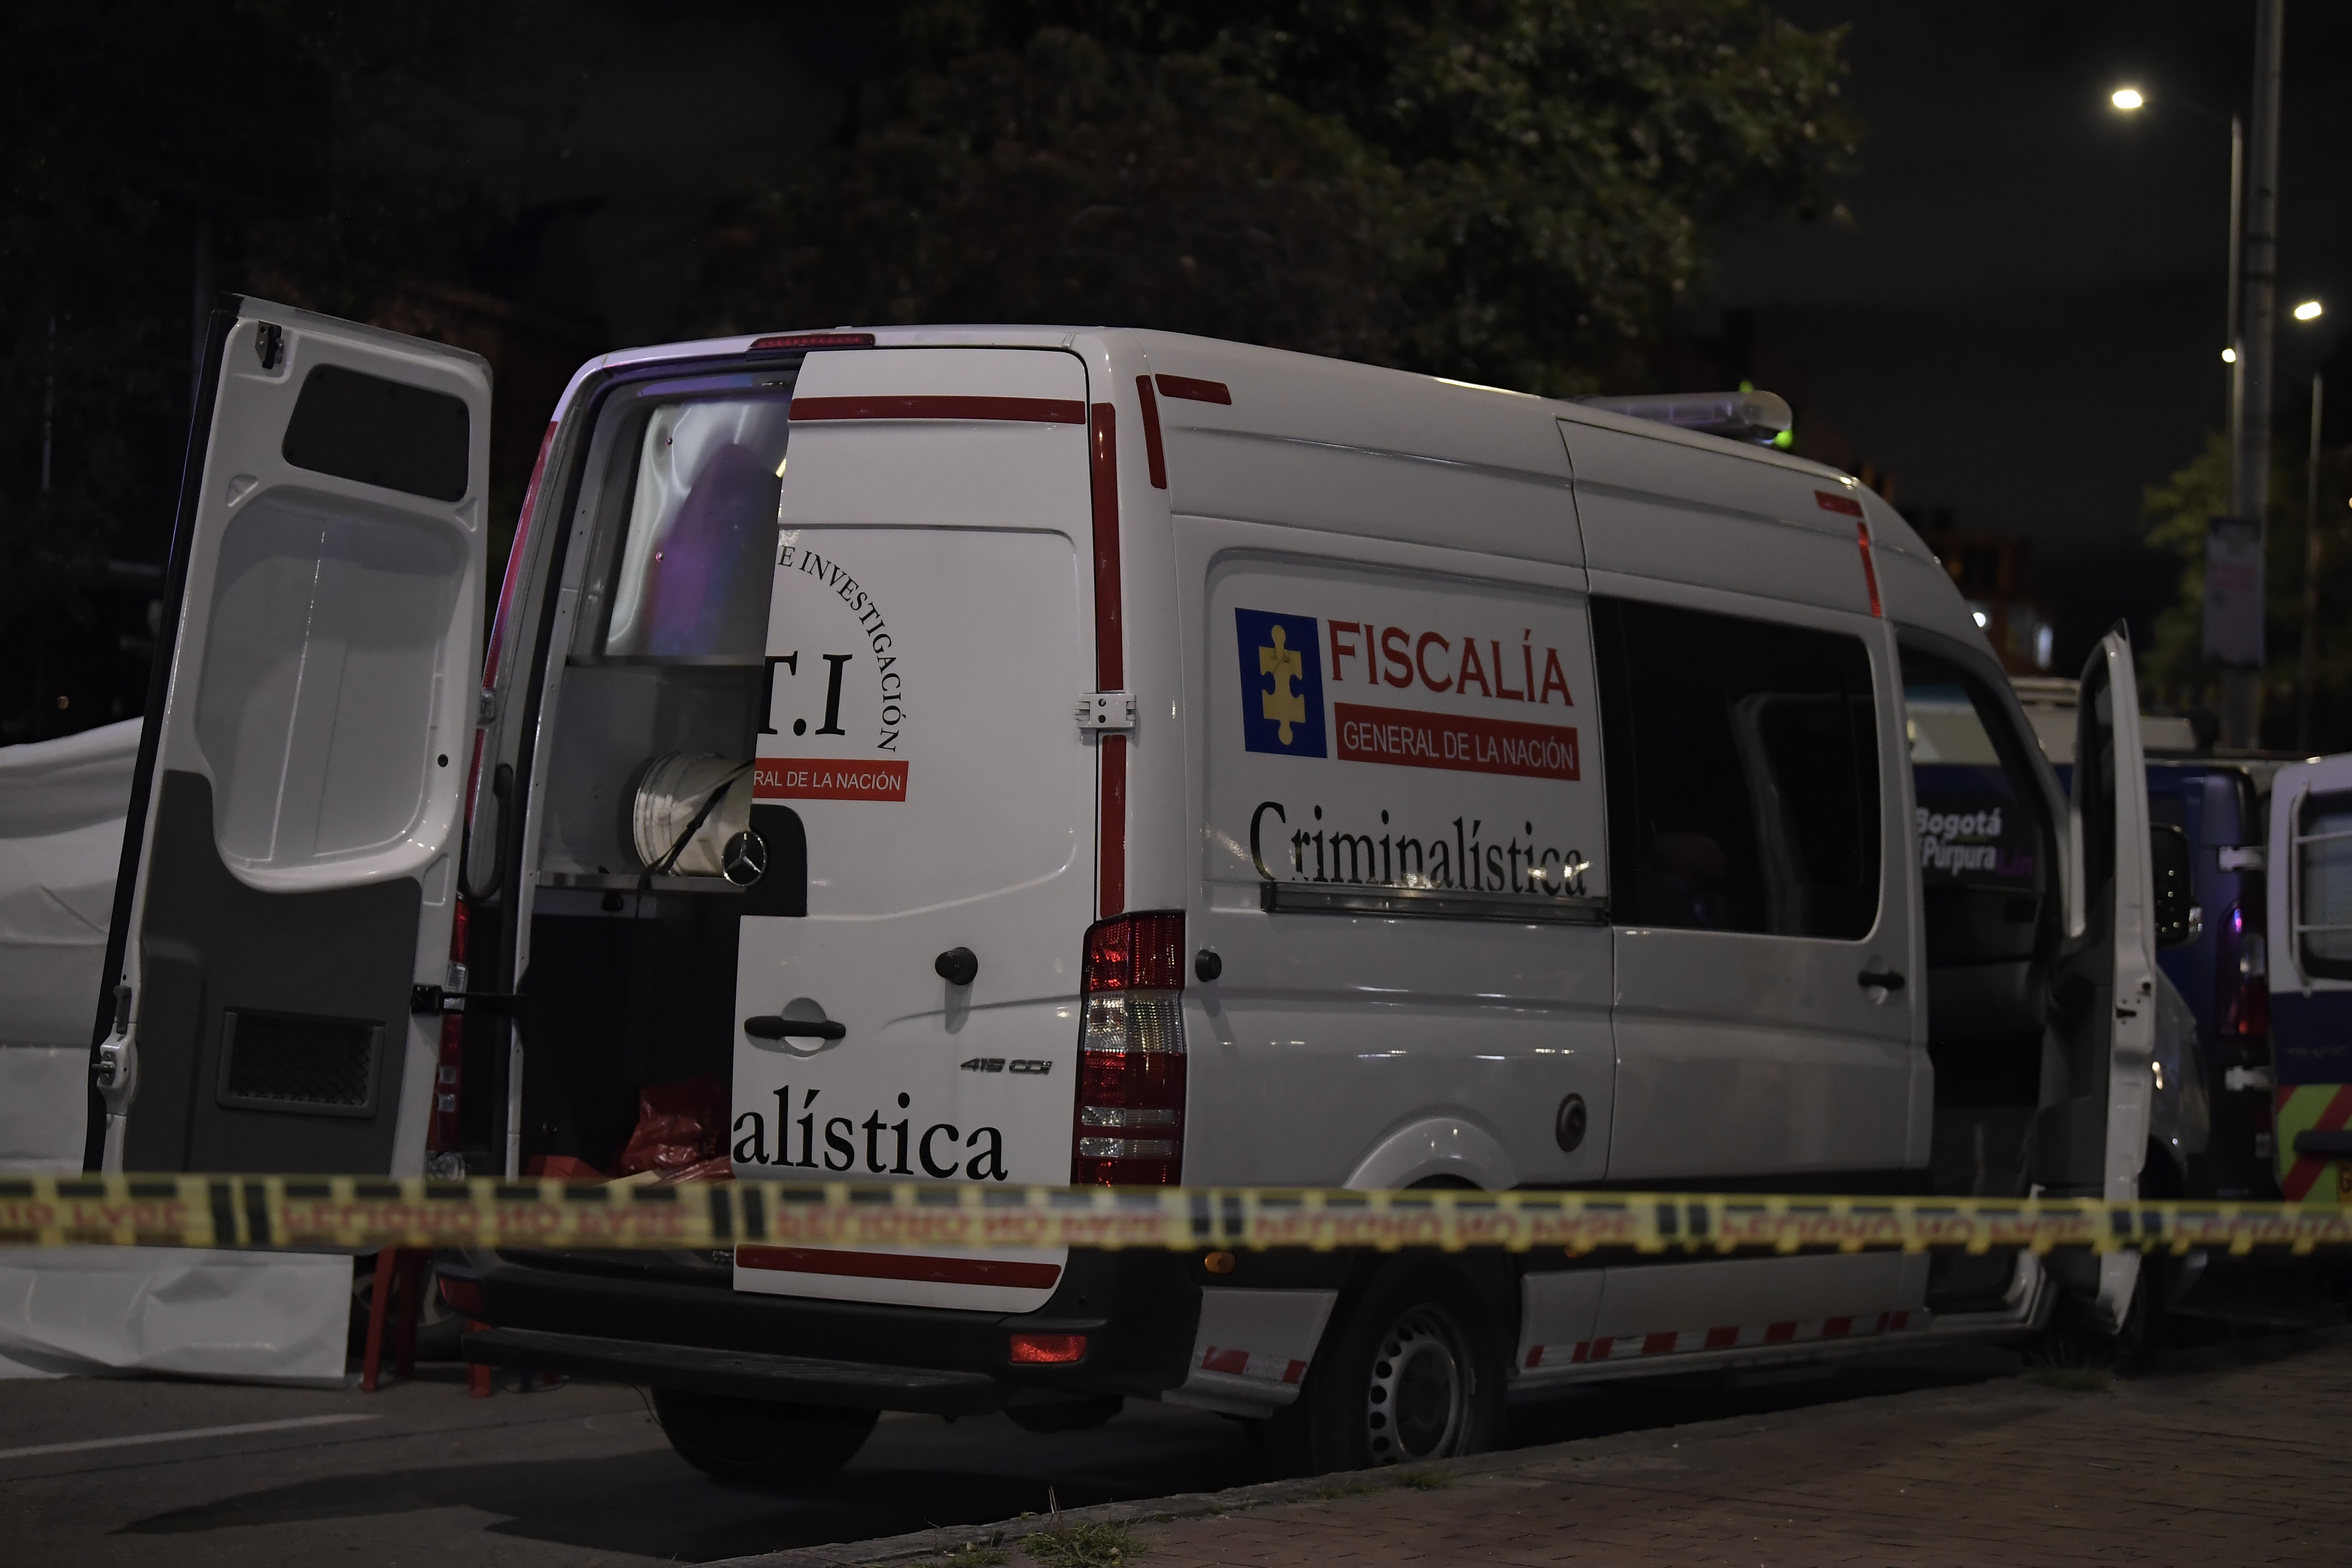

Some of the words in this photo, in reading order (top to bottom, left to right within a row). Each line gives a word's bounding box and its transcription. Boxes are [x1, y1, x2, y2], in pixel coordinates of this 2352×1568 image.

[798, 550, 906, 753] INVESTIGACIÓN
[1327, 619, 1574, 706] FISCALÍA
[754, 770, 782, 787] RAL
[787, 771, 808, 787] DE
[812, 772, 832, 788] LA
[836, 771, 901, 790] NACIÓN
[1344, 721, 1439, 757] GENERAL
[1443, 731, 1470, 760] DE
[1476, 735, 1500, 762] LA
[1503, 736, 1573, 770] NACIÓN
[1250, 801, 1587, 896] Criminalística
[1916, 806, 2003, 841] Bogotá
[732, 1085, 1009, 1181] alística
